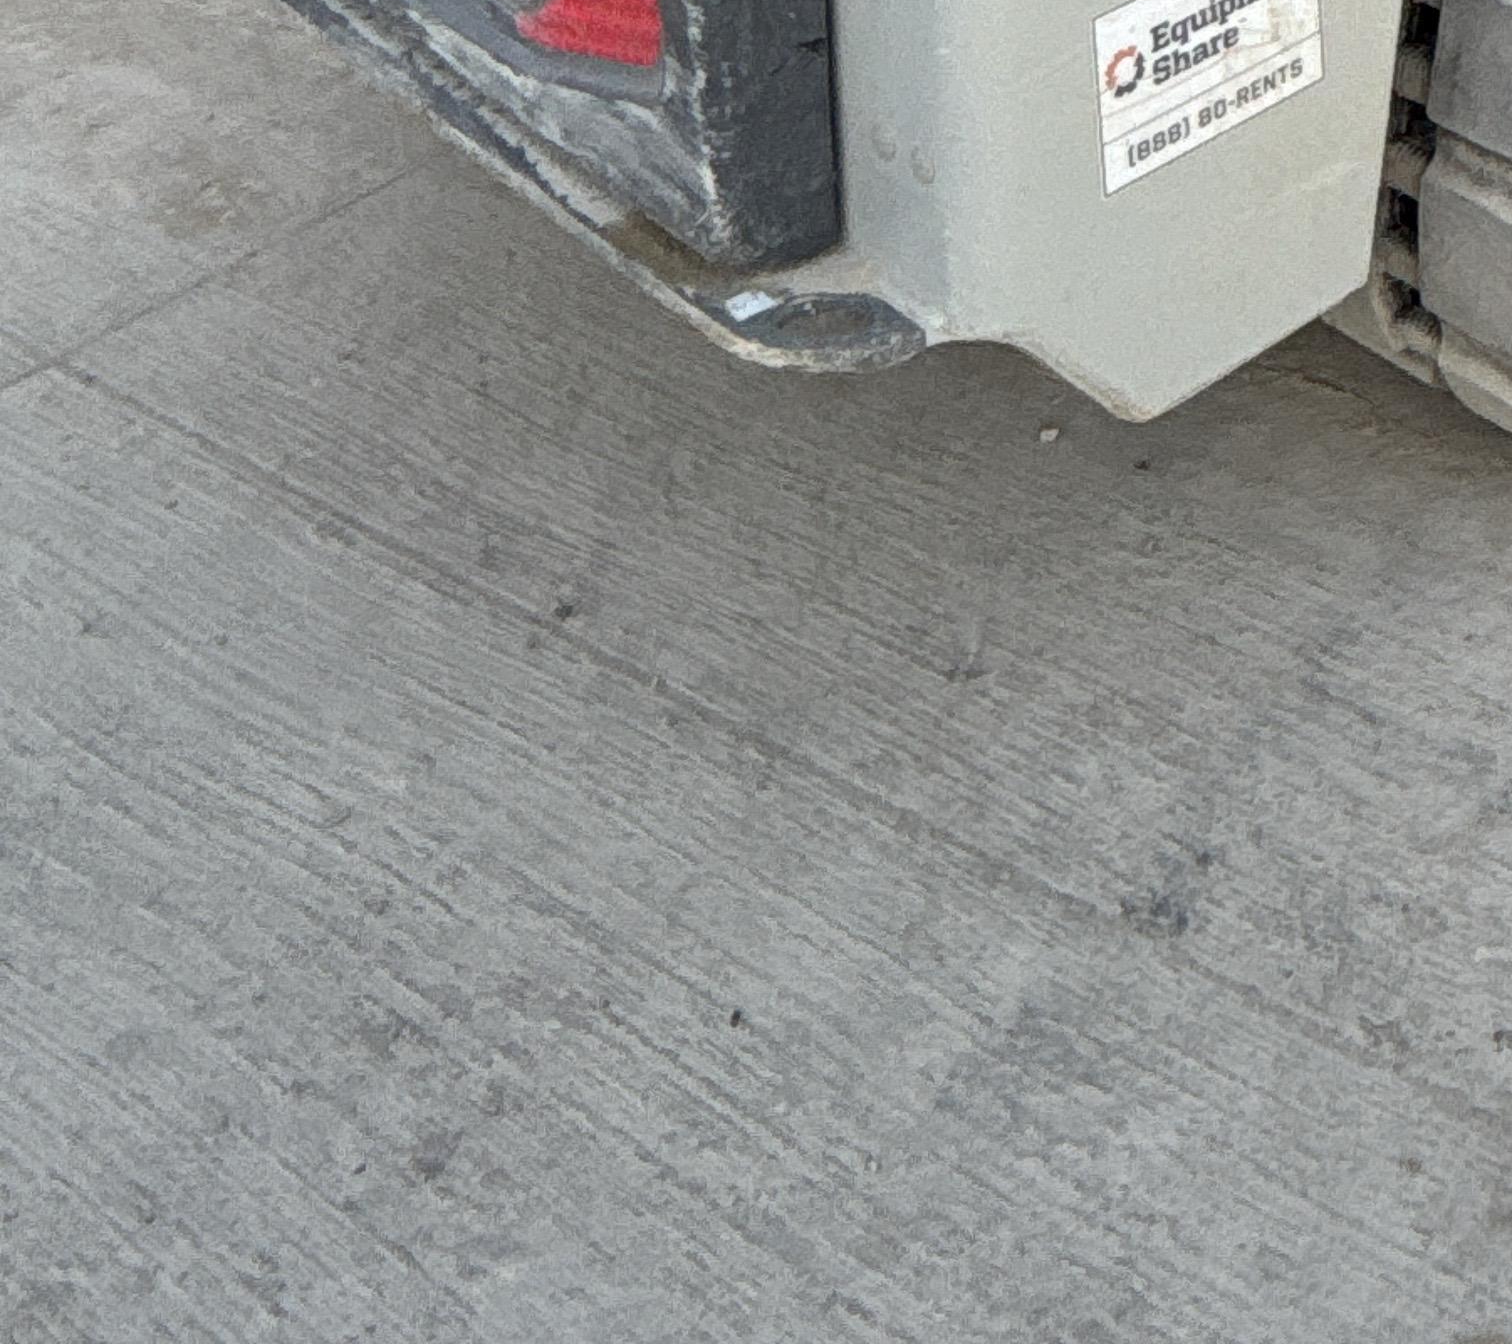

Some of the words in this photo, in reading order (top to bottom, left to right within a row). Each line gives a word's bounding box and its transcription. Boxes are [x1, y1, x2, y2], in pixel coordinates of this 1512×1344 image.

[1151, 26, 1240, 85] Share
[1126, 115, 1191, 168] (888)
[1197, 58, 1305, 128] 80-RENTS
